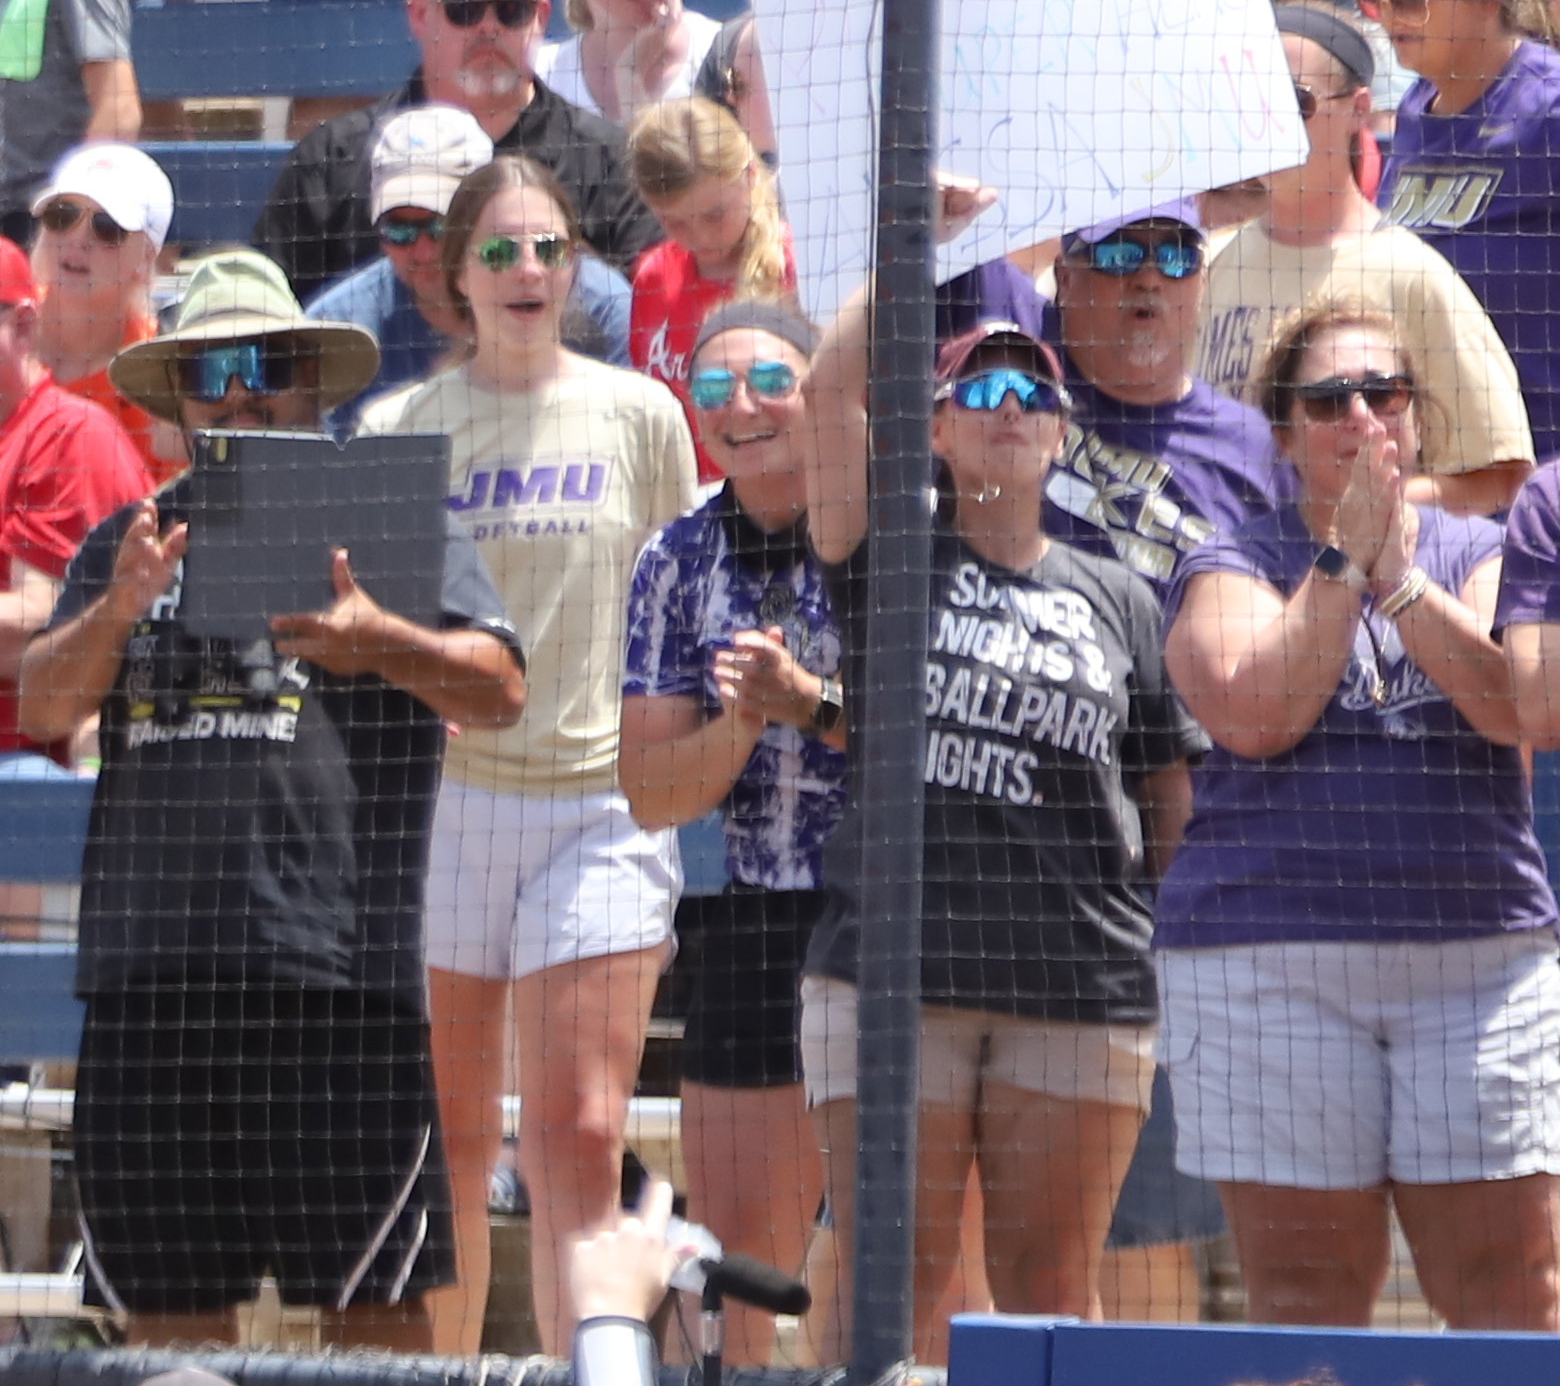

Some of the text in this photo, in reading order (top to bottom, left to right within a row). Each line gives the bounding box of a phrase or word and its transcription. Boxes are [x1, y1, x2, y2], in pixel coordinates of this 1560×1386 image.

[446, 462, 608, 513] JMU
[474, 515, 590, 541] OFTBALL
[950, 561, 1094, 643] SUMMER
[935, 610, 1114, 699] NIGHTS &
[219, 709, 300, 744] MINE
[925, 663, 1120, 767] BALLPARK
[924, 729, 1045, 807] IGHTS.
